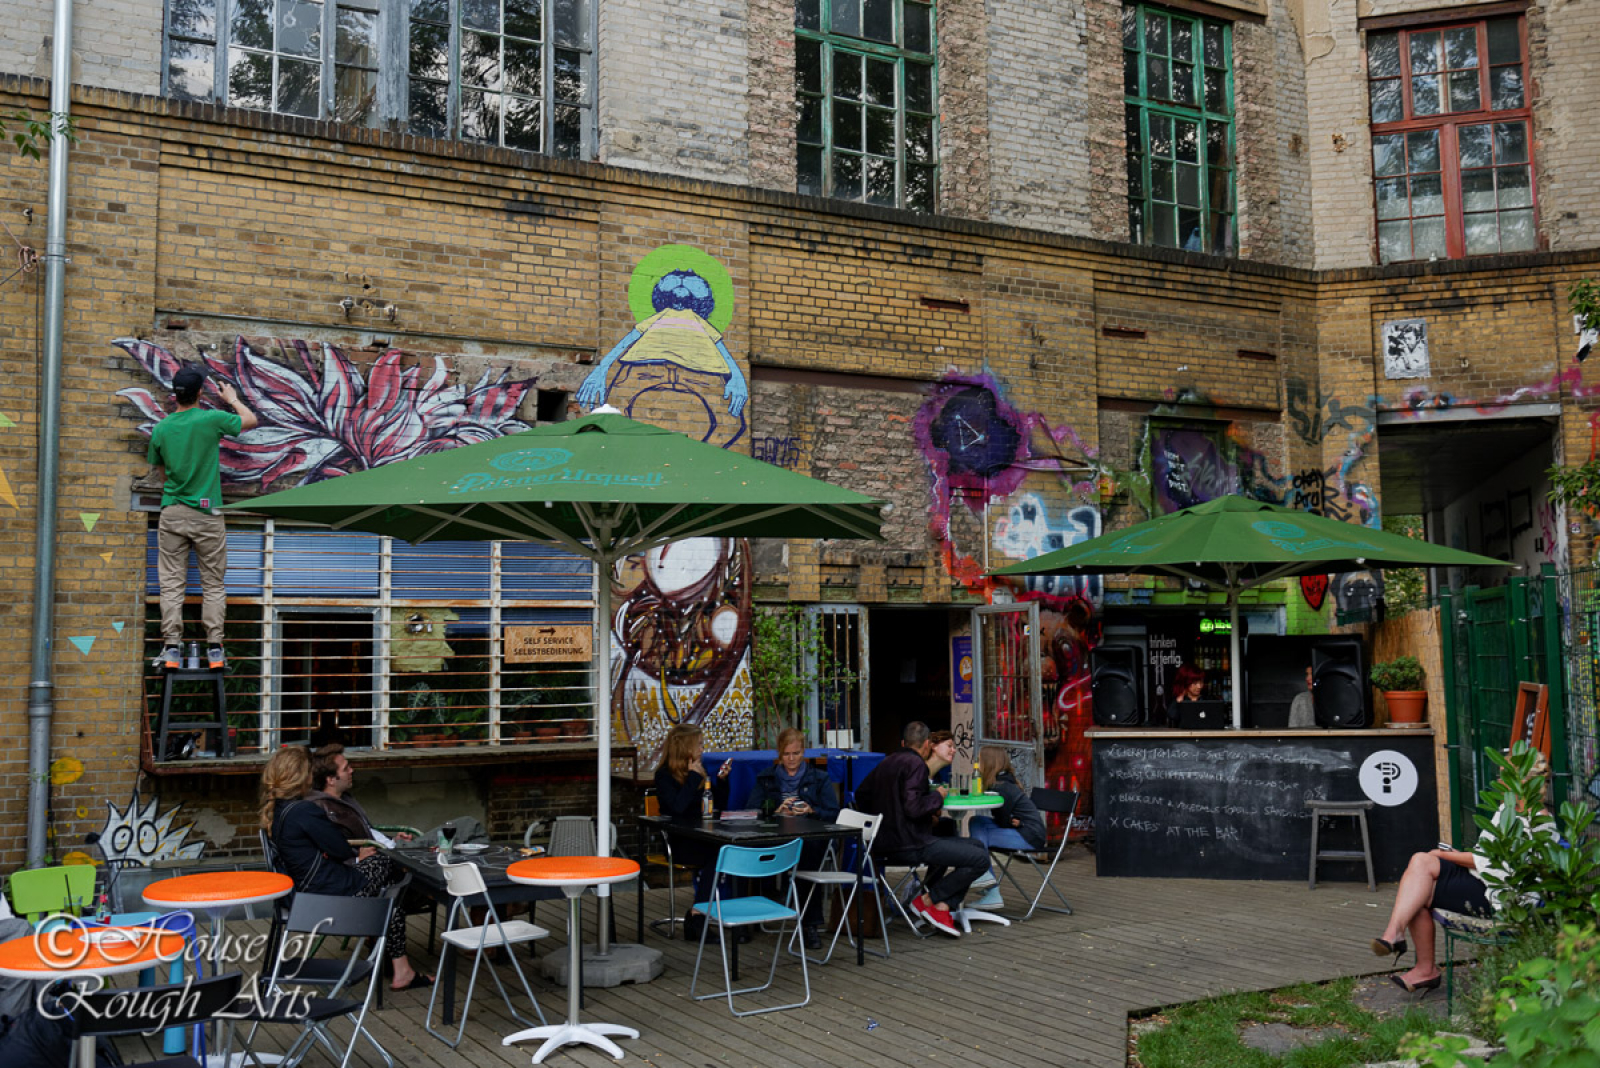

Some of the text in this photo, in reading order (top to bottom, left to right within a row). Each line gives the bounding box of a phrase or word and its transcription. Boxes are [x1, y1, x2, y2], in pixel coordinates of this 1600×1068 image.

[449, 467, 664, 494] Pilsner Urquell
[523, 636, 574, 645] SELF SERVICE
[1149, 634, 1177, 649] trinken
[513, 647, 584, 656] SELBSTBEDIENUNG
[1122, 817, 1161, 833] CAKES
[1166, 826, 1181, 838] AT
[1184, 826, 1211, 839] THE
